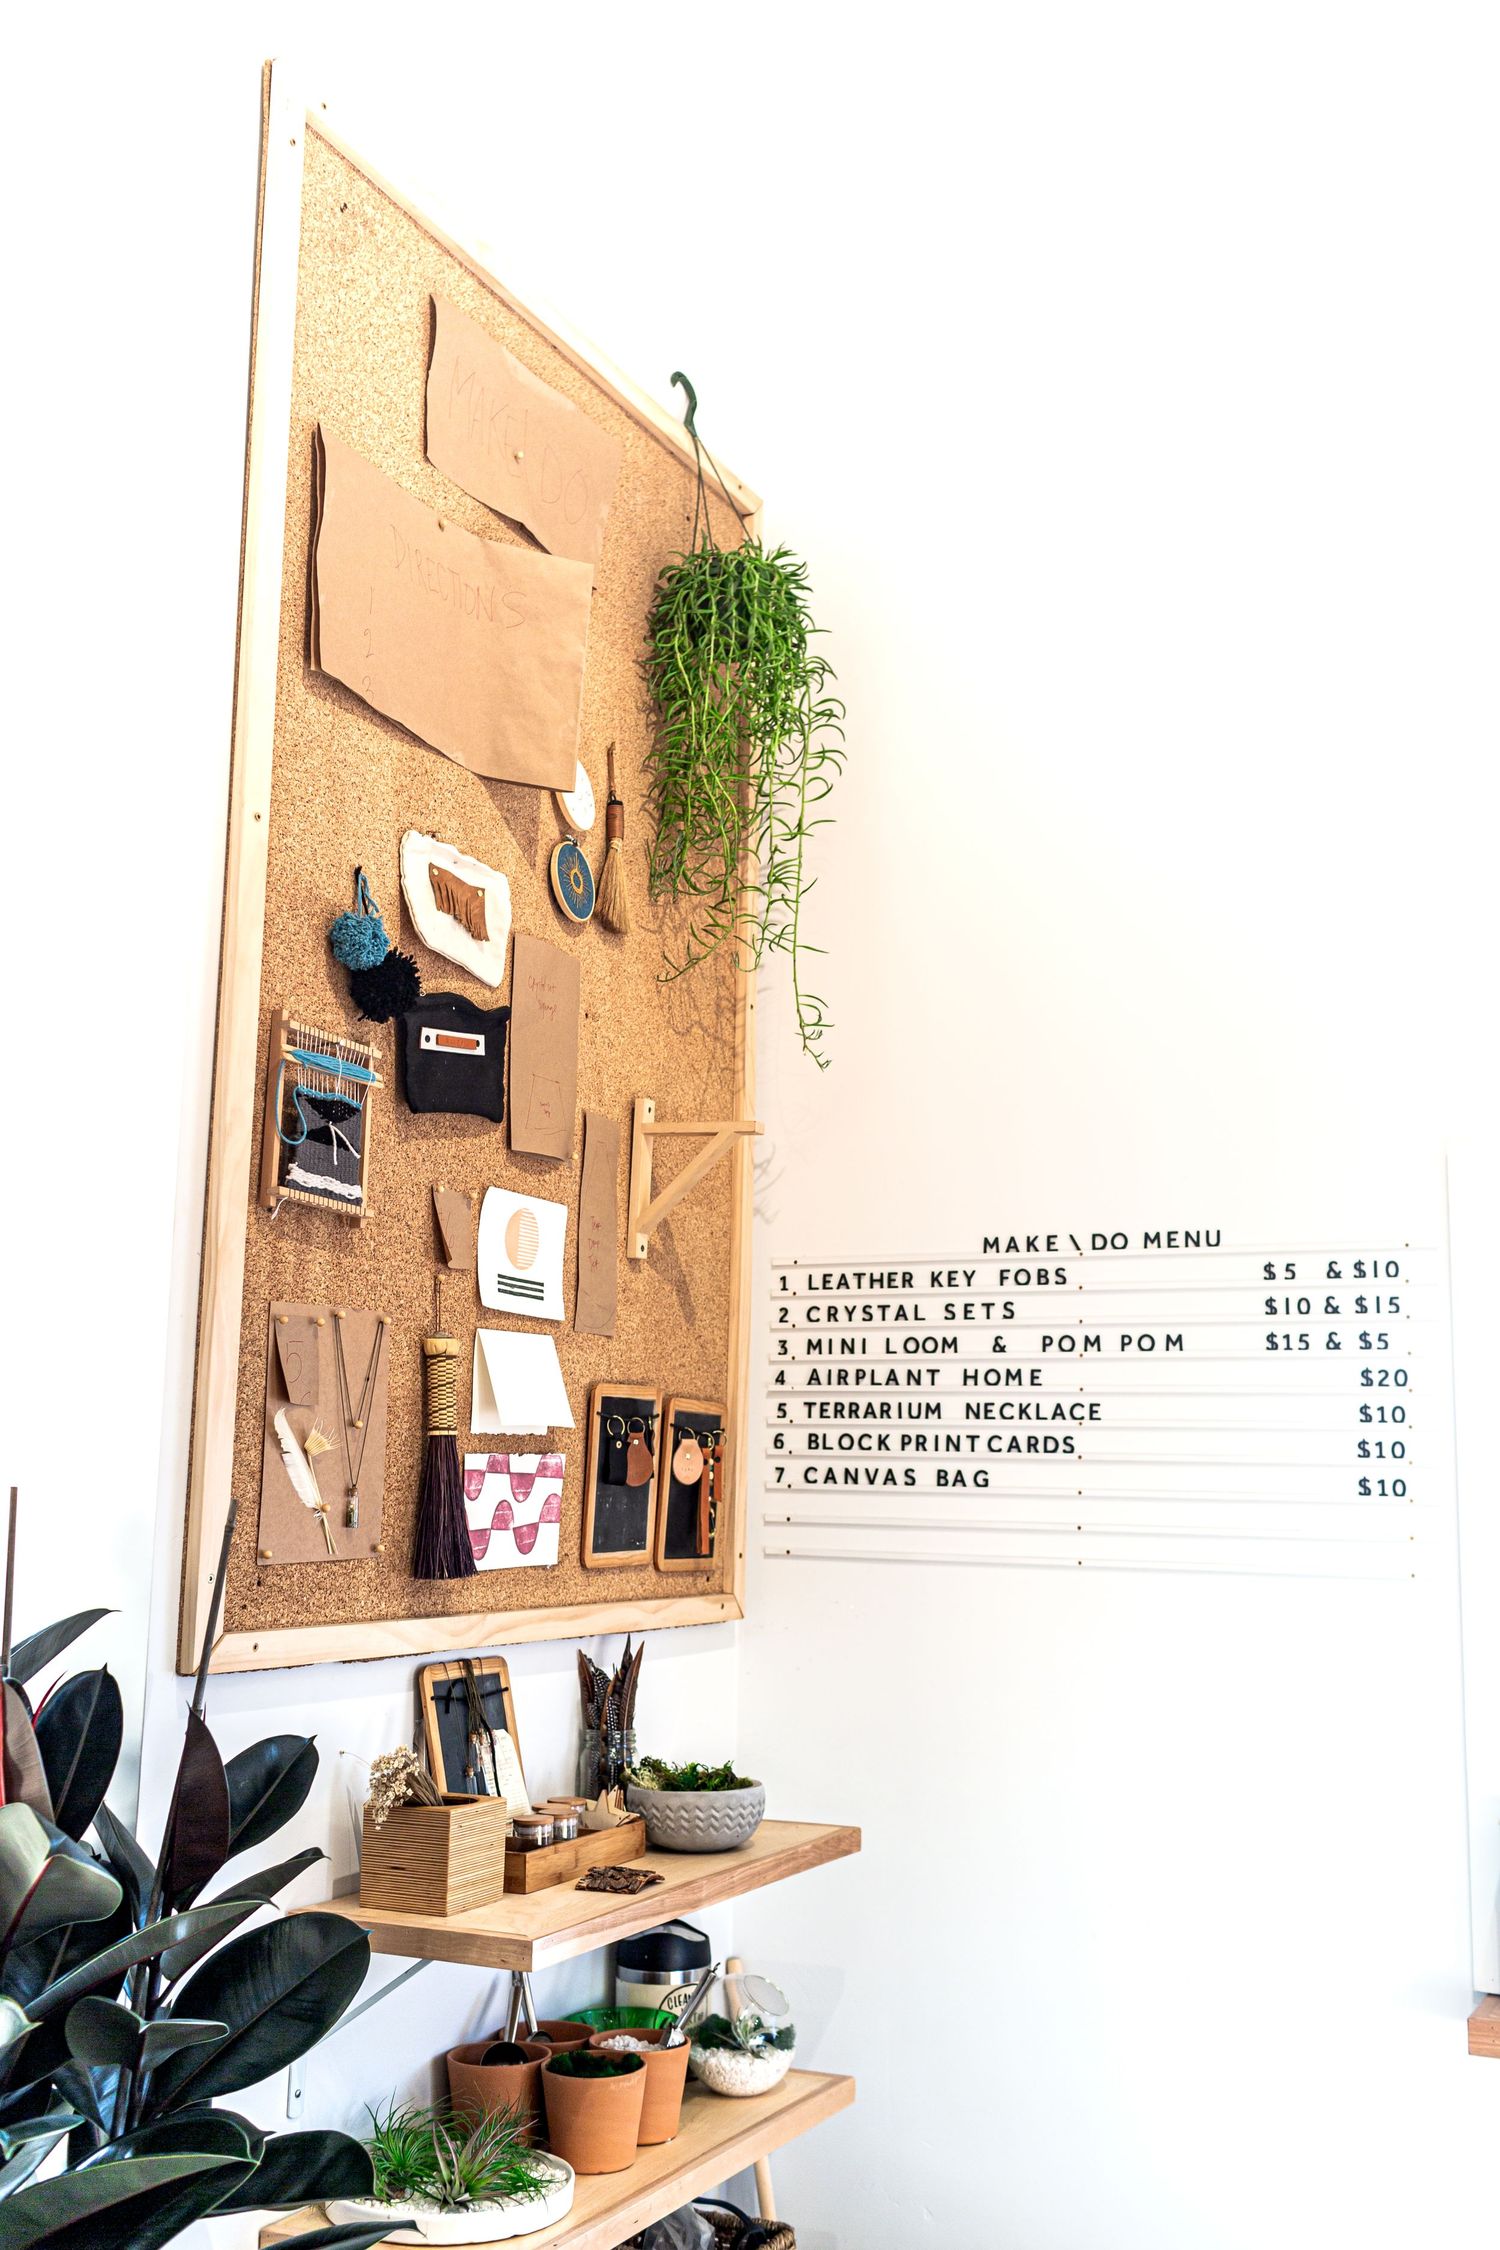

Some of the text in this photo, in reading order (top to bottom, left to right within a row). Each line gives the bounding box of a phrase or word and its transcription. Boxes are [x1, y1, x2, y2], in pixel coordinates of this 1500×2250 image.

[1144, 1230, 1220, 1249] MENU
[808, 1272, 913, 1290] LEATHER
[931, 1270, 976, 1288] KEY
[1000, 1268, 1067, 1286] FOBS
[1264, 1262, 1295, 1280] $5
[1327, 1261, 1342, 1279] &
[1354, 1260, 1399, 1278] $10
[806, 1304, 926, 1322] CRYSTAL
[944, 1301, 1014, 1320] SETS
[1265, 1297, 1310, 1315] $10
[1324, 1296, 1340, 1314] &
[1355, 1295, 1399, 1313] $15
[807, 1338, 866, 1355] MINI
[886, 1336, 958, 1354] LOOM
[992, 1336, 1006, 1353] &
[1042, 1335, 1101, 1352] POM
[1121, 1334, 1183, 1351] POM
[1266, 1332, 1309, 1350] $15
[1326, 1332, 1341, 1350] &
[1359, 1331, 1388, 1350] $5
[806, 1368, 940, 1386] AIRPLANT
[963, 1368, 1042, 1386] HOME
[1361, 1368, 1408, 1386] $20
[803, 1402, 941, 1419] TERRARIUM
[966, 1402, 1101, 1420] NECKLACE
[1360, 1404, 1405, 1423] $10
[1358, 1439, 1405, 1458] $10
[804, 1466, 916, 1486] CANVAS
[937, 1469, 988, 1487] BAG
[1359, 1477, 1406, 1497] $10
